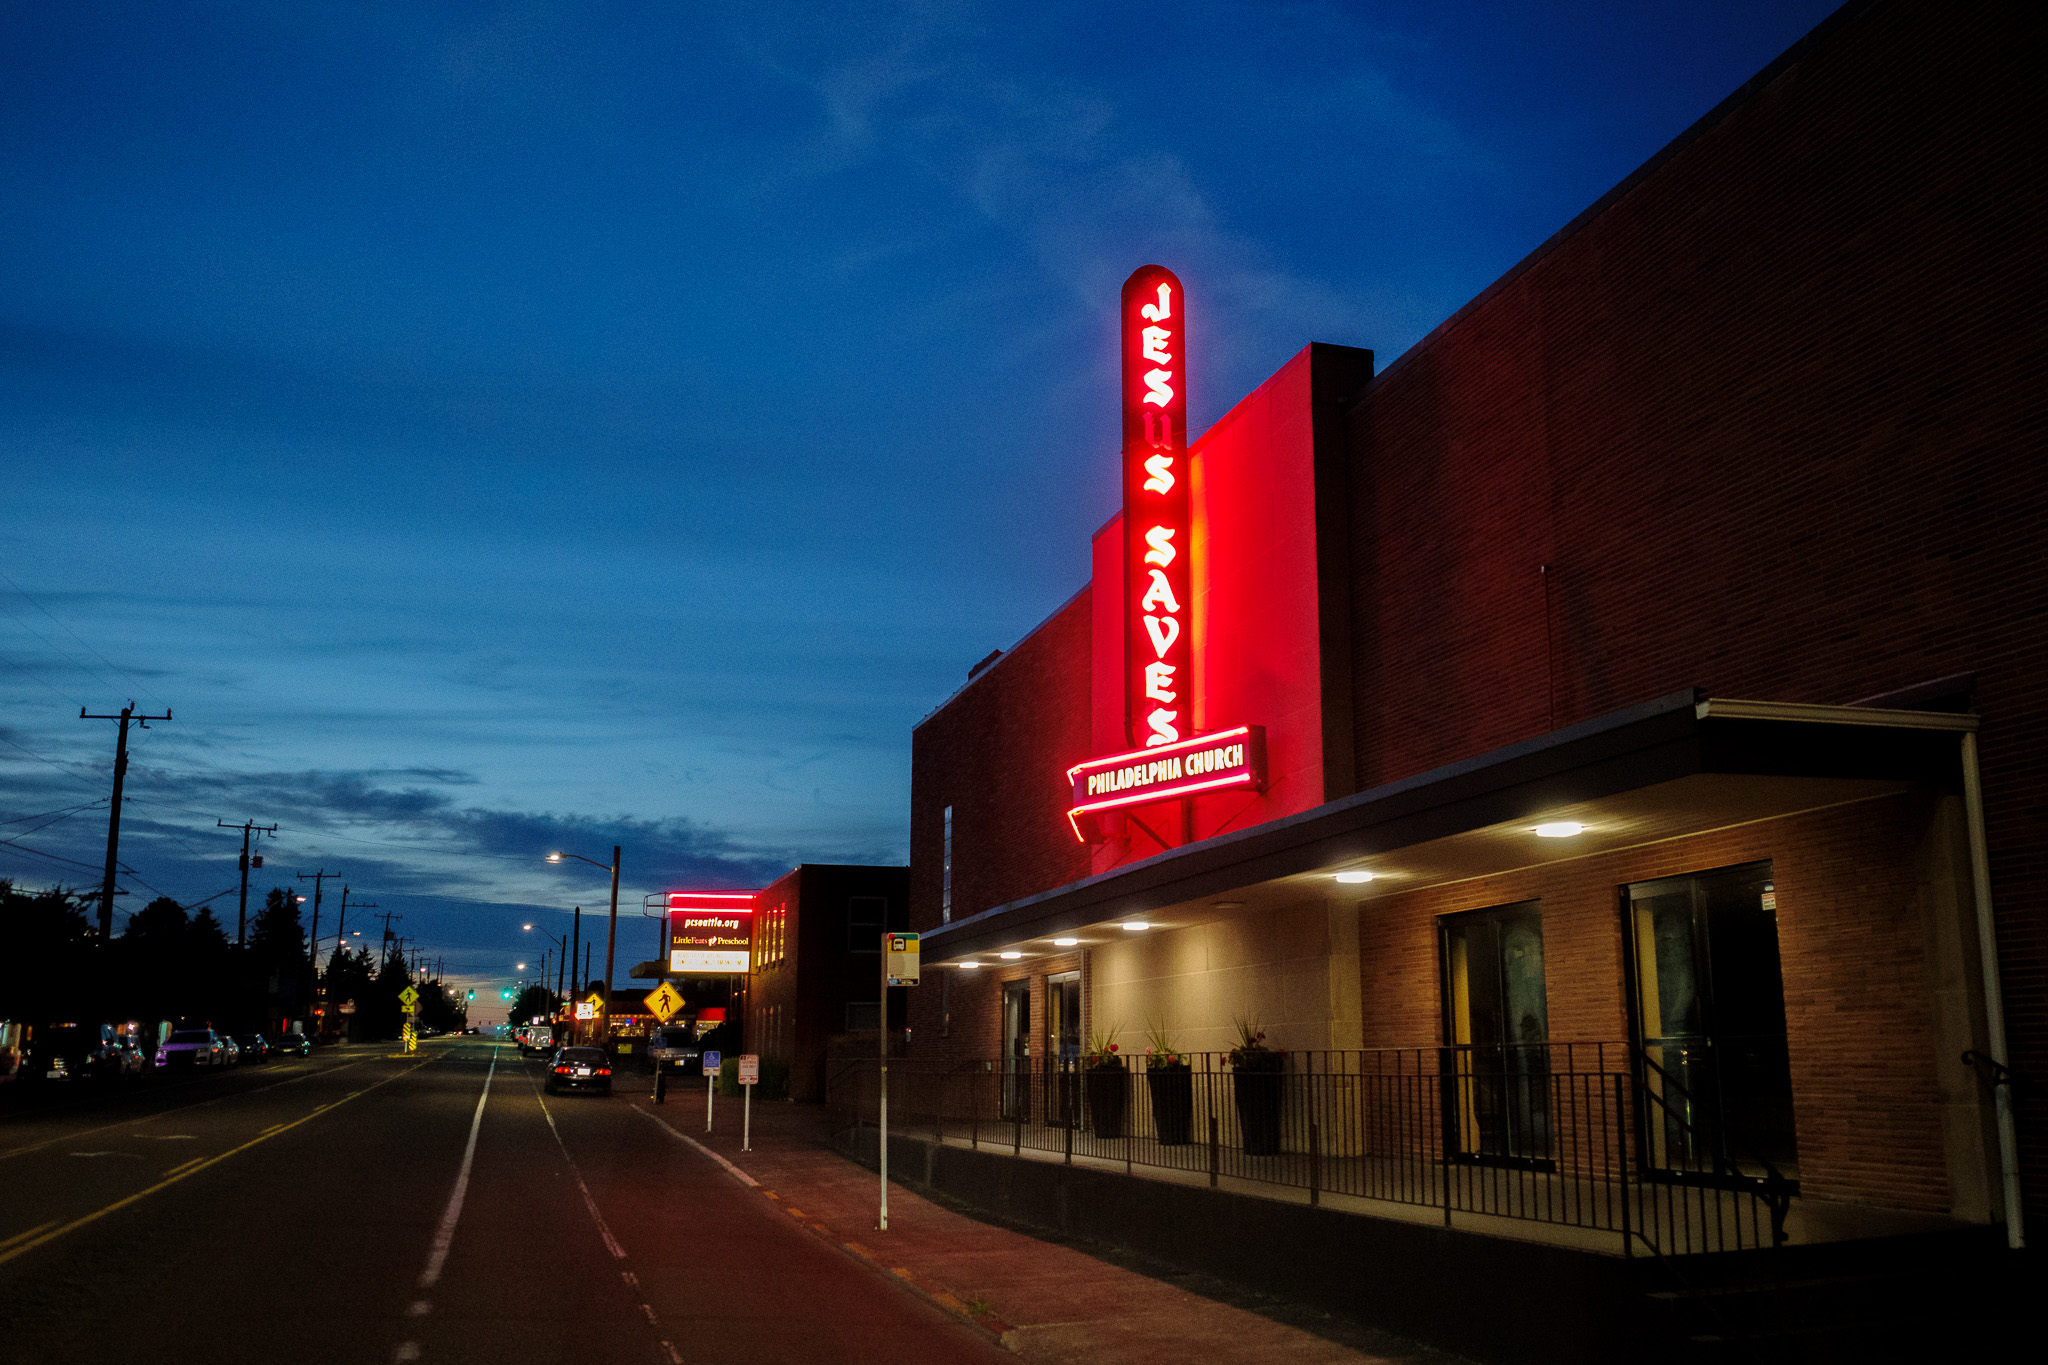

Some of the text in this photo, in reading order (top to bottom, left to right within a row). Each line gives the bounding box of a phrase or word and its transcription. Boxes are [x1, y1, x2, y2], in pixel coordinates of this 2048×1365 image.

[1141, 282, 1181, 747] JESUS SAVES
[1087, 743, 1244, 796] PHILADELPHIA CHURCH
[685, 917, 739, 929] pcseattle.org
[717, 937, 749, 945] Preschool
